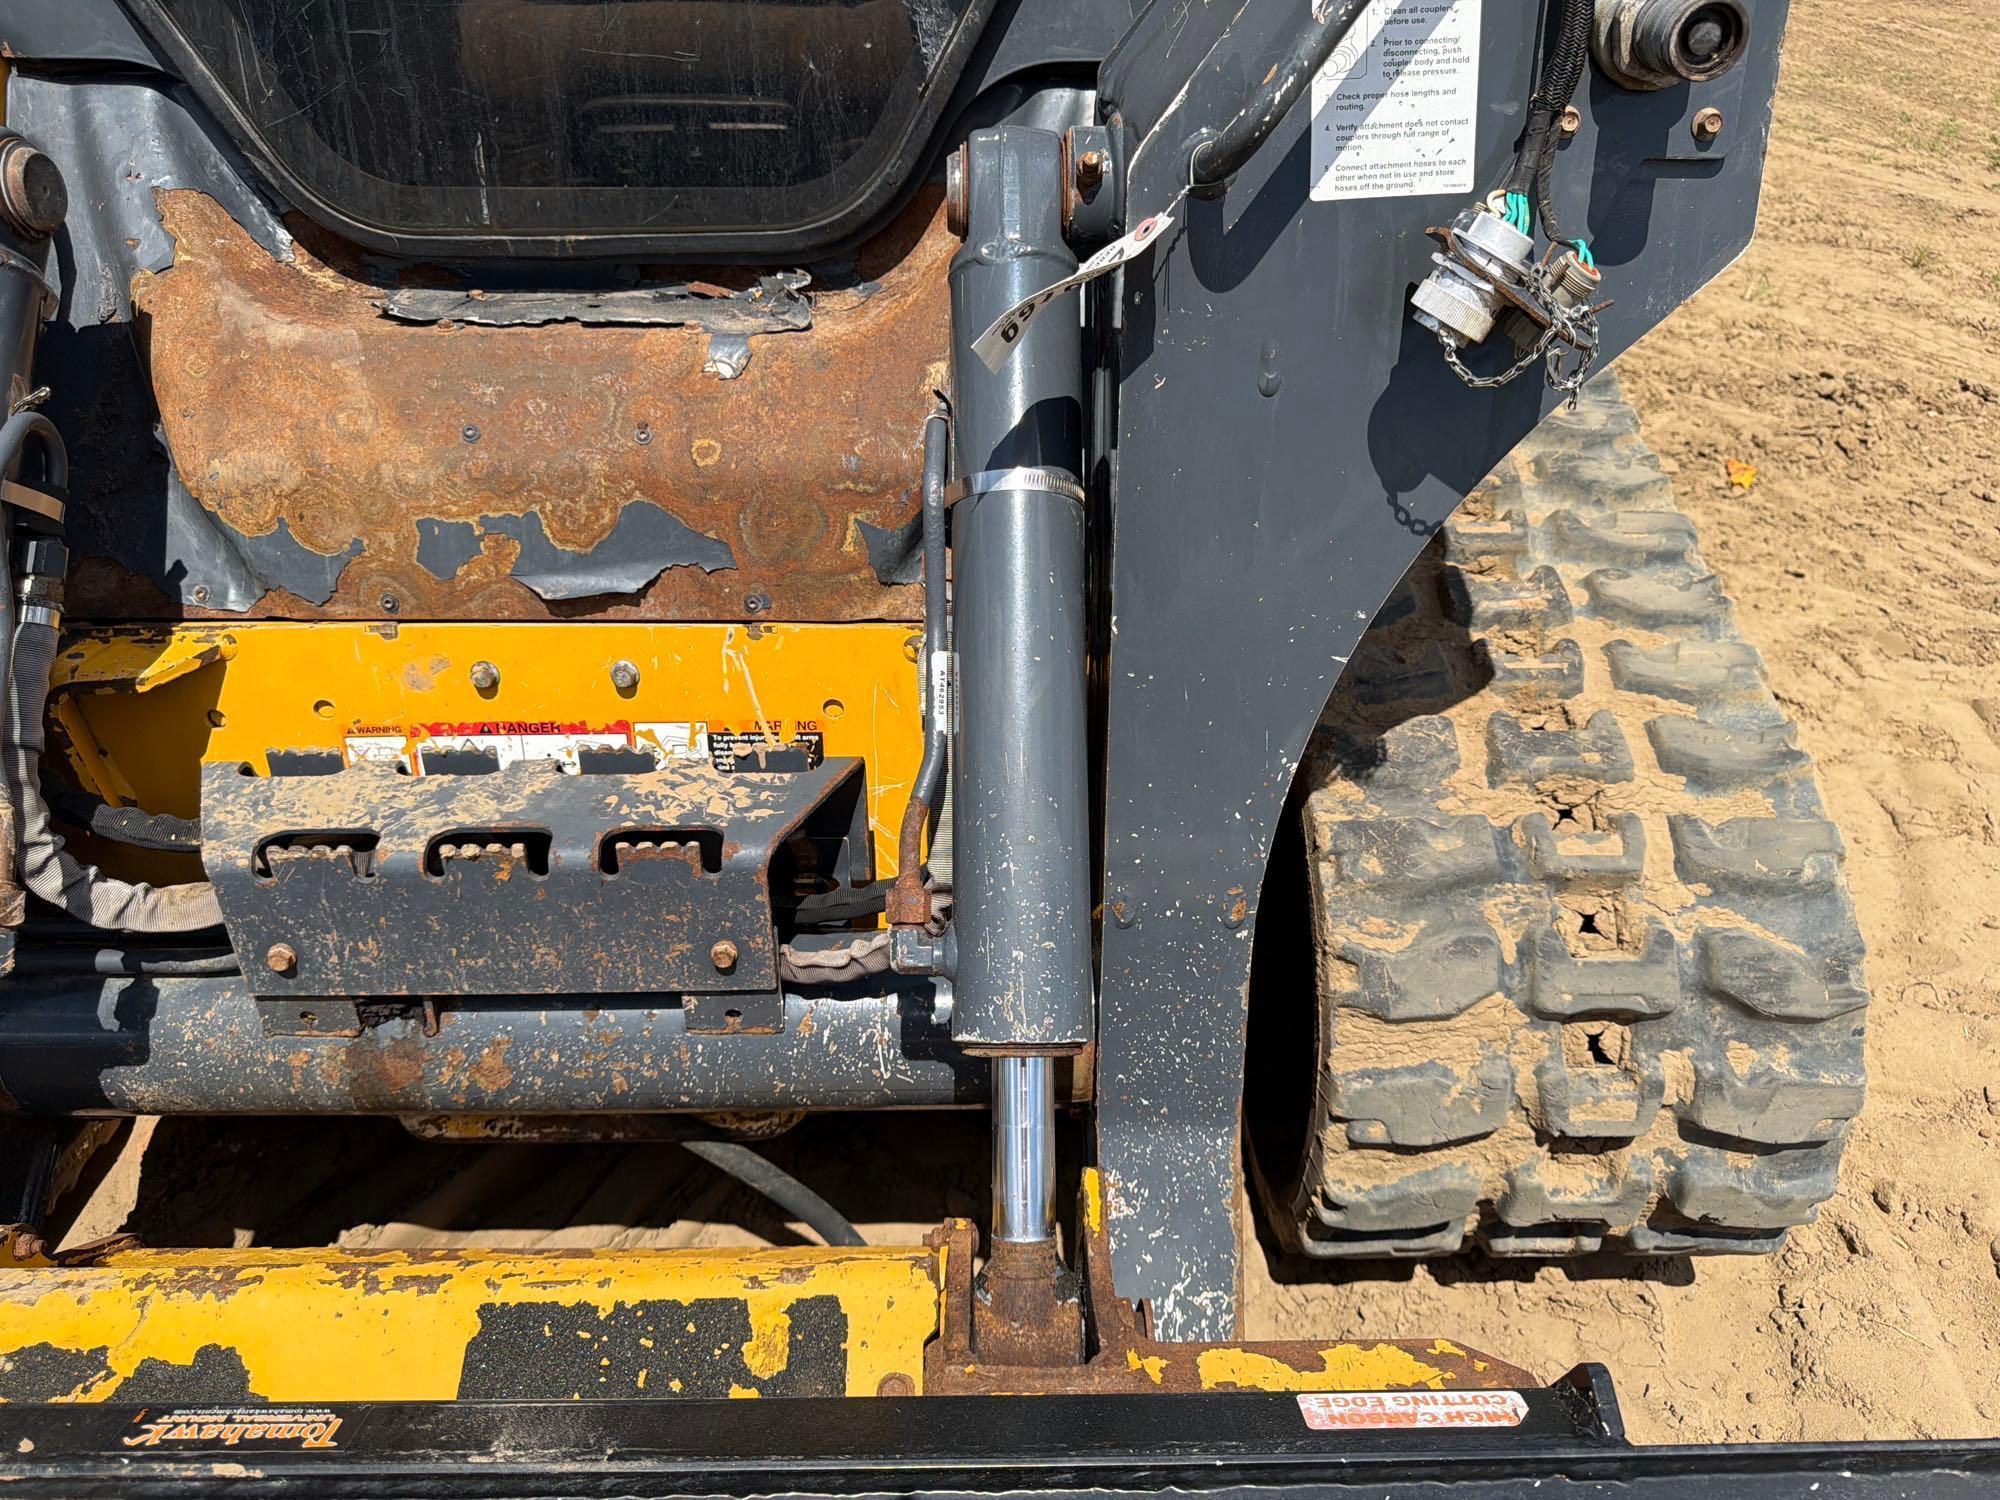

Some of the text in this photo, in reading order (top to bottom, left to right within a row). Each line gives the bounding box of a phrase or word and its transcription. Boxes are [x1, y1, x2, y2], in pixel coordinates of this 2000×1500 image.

[1415, 36, 1460, 44] connecting/
[1383, 48, 1440, 57] disconnecting,
[1383, 60, 1411, 68] coupler
[1412, 89, 1439, 97] lengths
[1336, 103, 1365, 111] routing.
[1336, 124, 1358, 132] Verify
[1386, 182, 1415, 190] ground.
[357, 725, 402, 734] WARNING
[1314, 1395, 1507, 1408] CUTTING EDGE
[156, 1414, 336, 1423] UNIVERSAL MOUNT
[1328, 1410, 1513, 1425] HIGH CARBON
